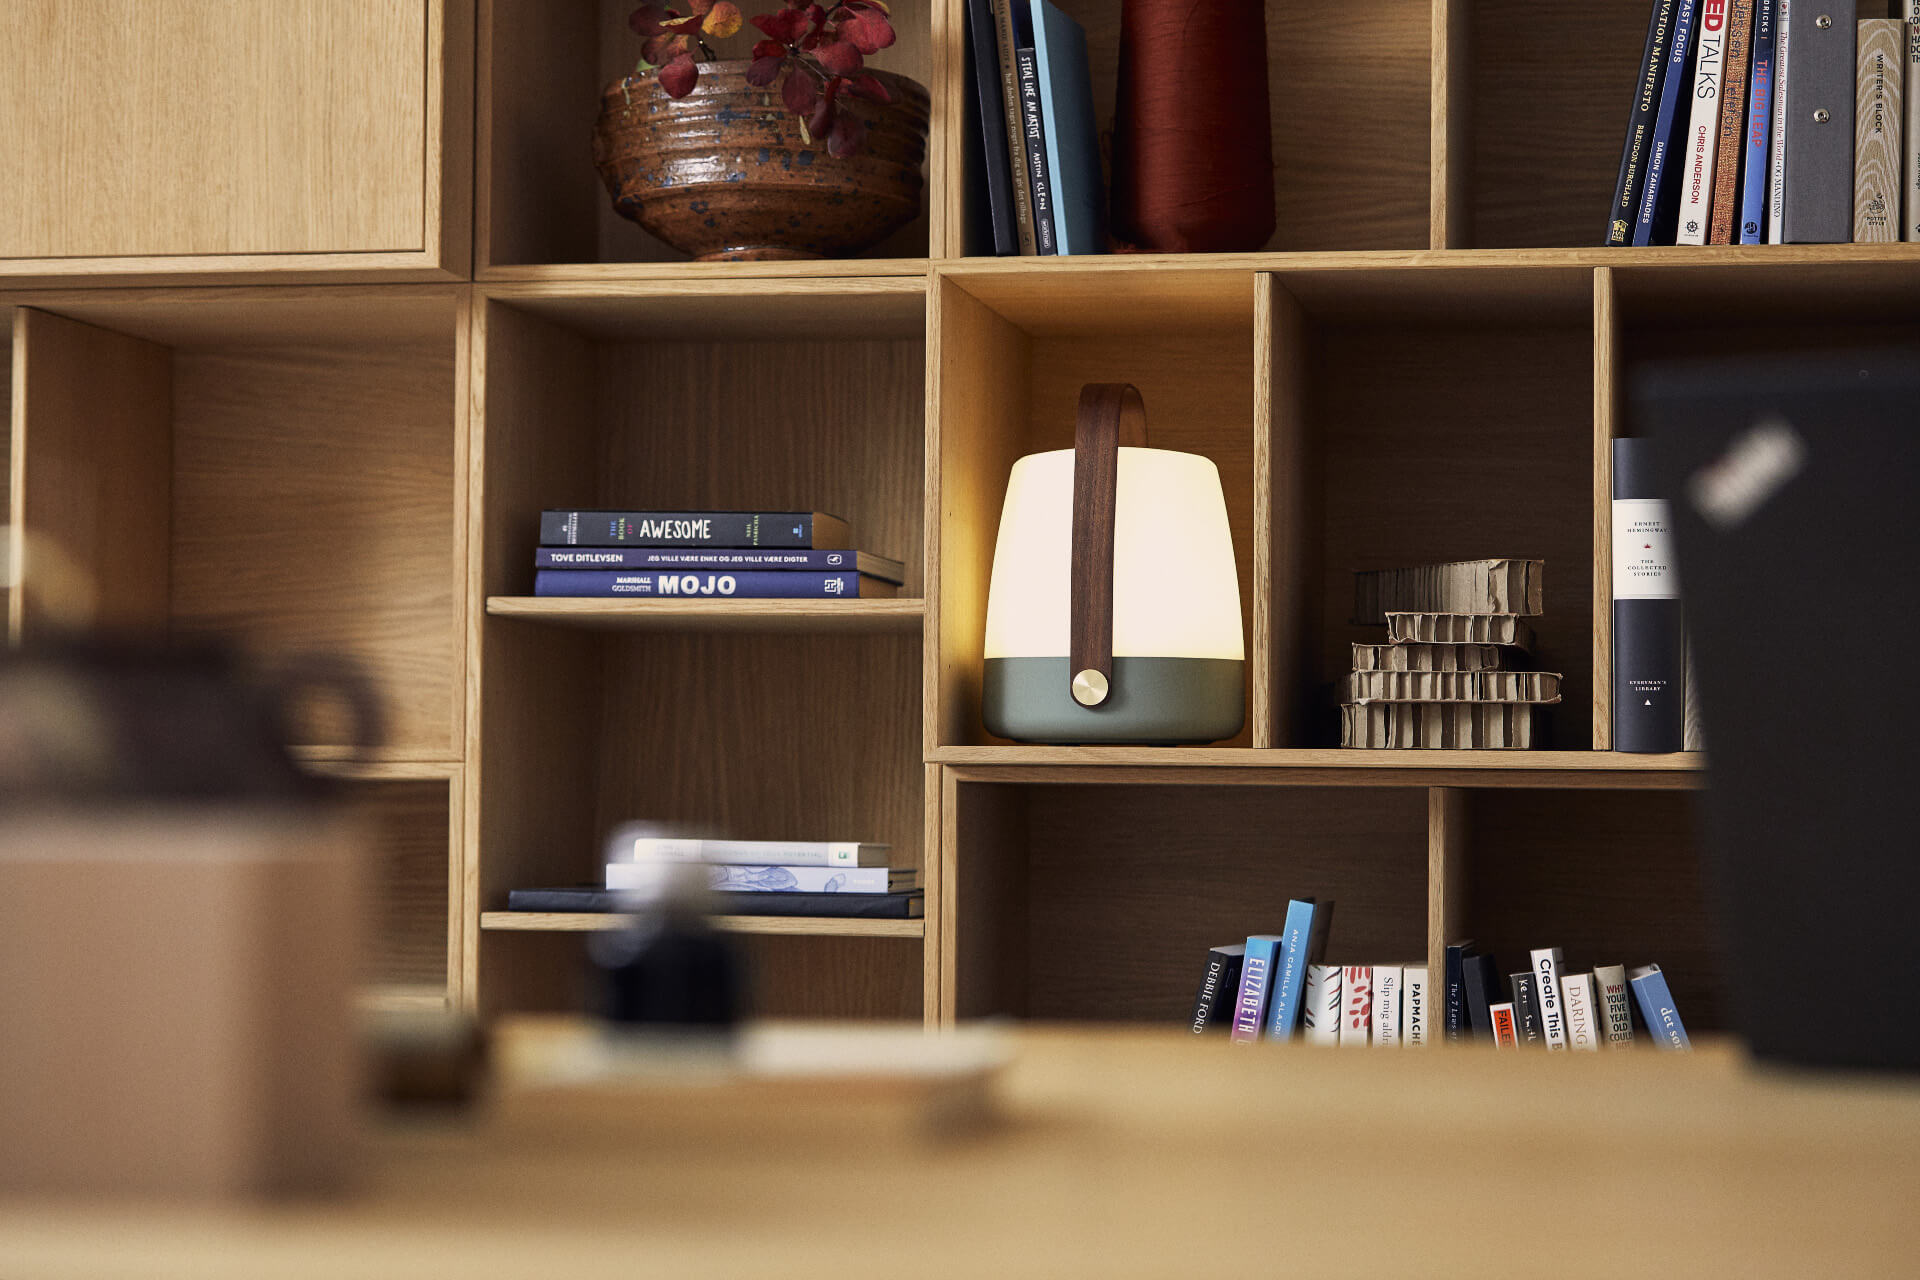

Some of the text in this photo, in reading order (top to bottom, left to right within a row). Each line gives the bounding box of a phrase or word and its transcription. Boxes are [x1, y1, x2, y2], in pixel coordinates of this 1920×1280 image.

[1673, 0, 1693, 63] FAST FOCUS
[1780, 31, 1788, 45] The
[1697, 35, 1721, 99] TALKS
[1779, 46, 1787, 78] Greatest
[1640, 46, 1662, 112] MANIFESTO
[1723, 76, 1744, 137] Telefon
[1751, 59, 1768, 148] THE BIG LEAP
[1777, 79, 1786, 117] Salesman
[1875, 54, 1884, 134] WRITER'S BLOCK
[1021, 56, 1047, 210] STEAL LIKE AN ARTIST AUSTIN KLEON
[1776, 126, 1784, 137] the
[1775, 139, 1784, 160] World
[1621, 124, 1645, 208] BRENDON BURCHARD
[1691, 125, 1707, 204] CHRIS ANDERSON
[1642, 141, 1665, 224] DAMON ZAHARIADES
[1773, 179, 1782, 217] MANDINO
[639, 519, 712, 539] AWESOME
[550, 553, 624, 563] TOVE DITLEVSEN
[731, 555, 743, 563] JEG
[744, 555, 763, 563] VILLE
[658, 575, 737, 595] MOJO
[1290, 929, 1299, 953] ANJA
[1281, 956, 1294, 998] CAMILLA
[1381, 977, 1394, 997] Slip
[1451, 983, 1459, 997] The
[1540, 959, 1556, 1009] Create
[1606, 984, 1624, 994] WHY
[1192, 962, 1221, 1035] DEBBIE FORD
[1238, 958, 1265, 1034] ELIZABETH
[1519, 979, 1529, 1004] Keri
[1606, 994, 1627, 1004] YOUR
[1380, 999, 1393, 1020] mig
[1569, 986, 1588, 1045] DARING
[1609, 1013, 1629, 1023] YEAR
[1610, 1004, 1626, 1013] FIVE
[1660, 1007, 1674, 1029] det
[1547, 1012, 1561, 1039] This
[1609, 1031, 1633, 1042] COULD
[1613, 1023, 1628, 1032] OLD
